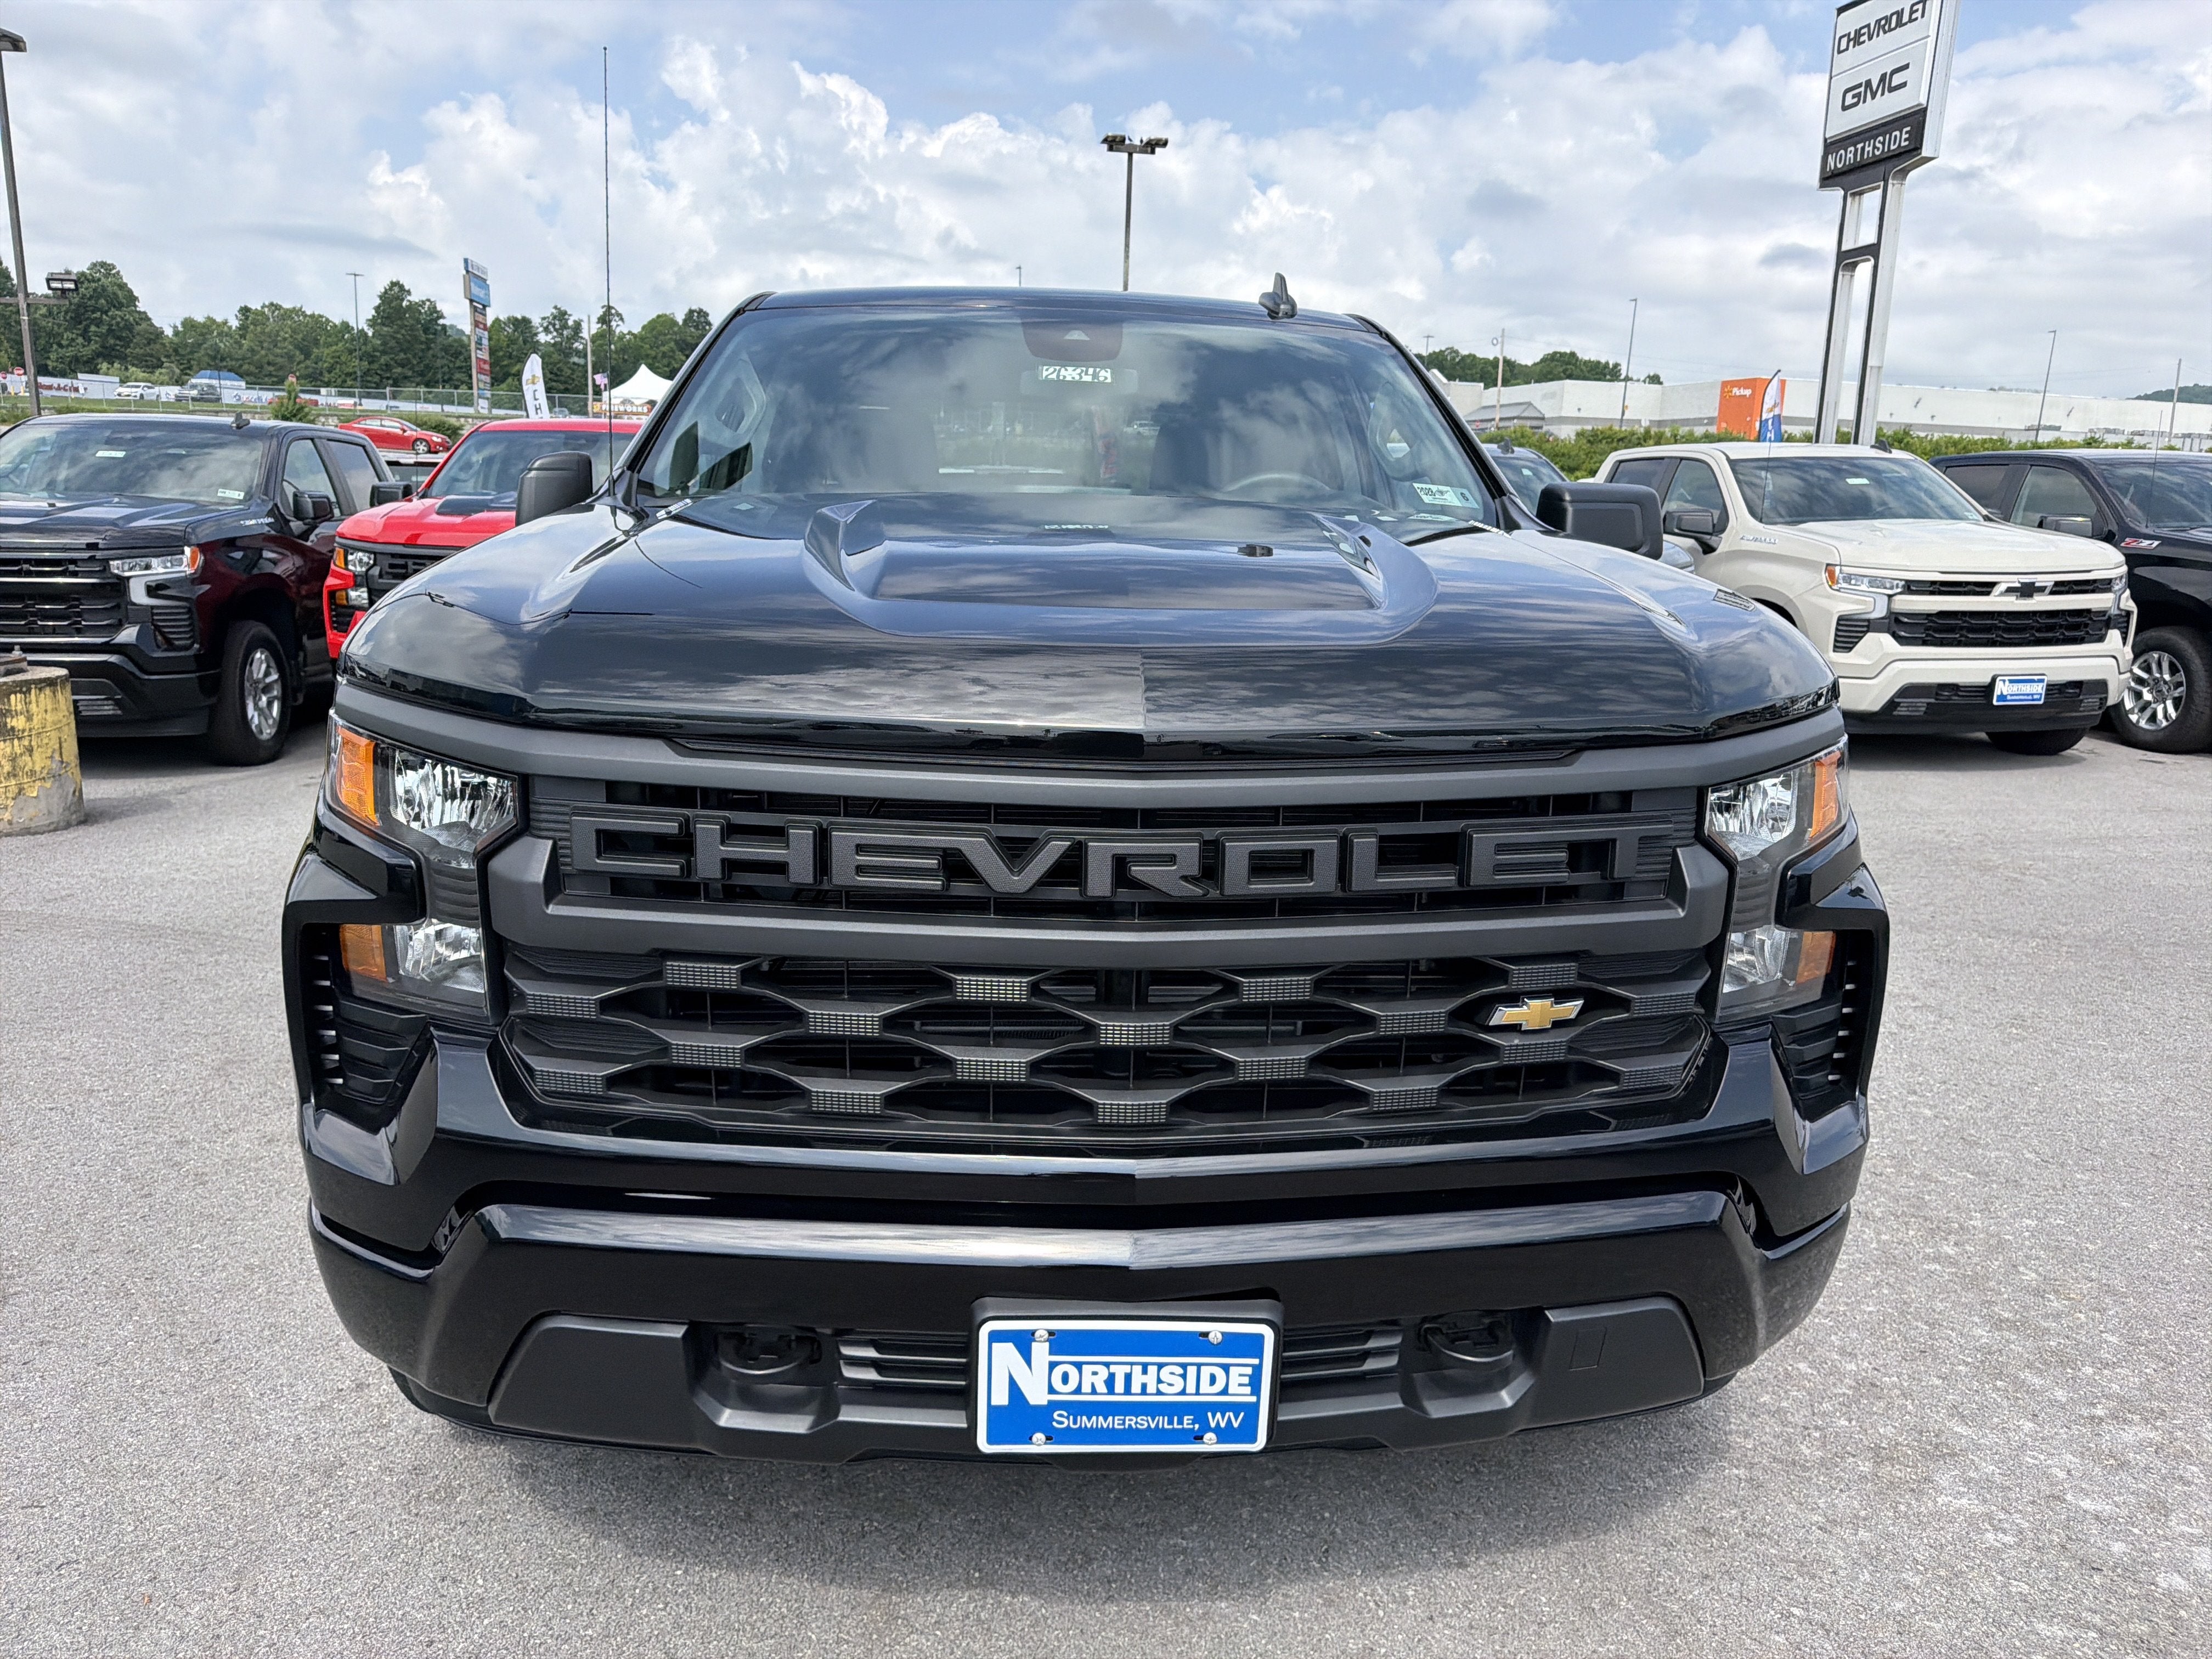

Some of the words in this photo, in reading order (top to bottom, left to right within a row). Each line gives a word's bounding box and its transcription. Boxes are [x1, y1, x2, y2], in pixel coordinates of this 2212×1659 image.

[1837, 0, 1927, 55] CHEVROLET
[1841, 62, 1910, 112] GMC
[1826, 126, 1911, 172] NORTHSIDE
[1732, 387, 1752, 398] Pickup
[1460, 492, 1469, 501] 6
[2120, 538, 2162, 549] Z71
[1997, 679, 2044, 695] NORTHSIDE
[569, 815, 1674, 899] CHEVROLET
[990, 1341, 1253, 1406] NORTHSIDE
[1052, 1410, 1200, 1431] SUMMERSVILLE,
[1207, 1411, 1245, 1428] WV
